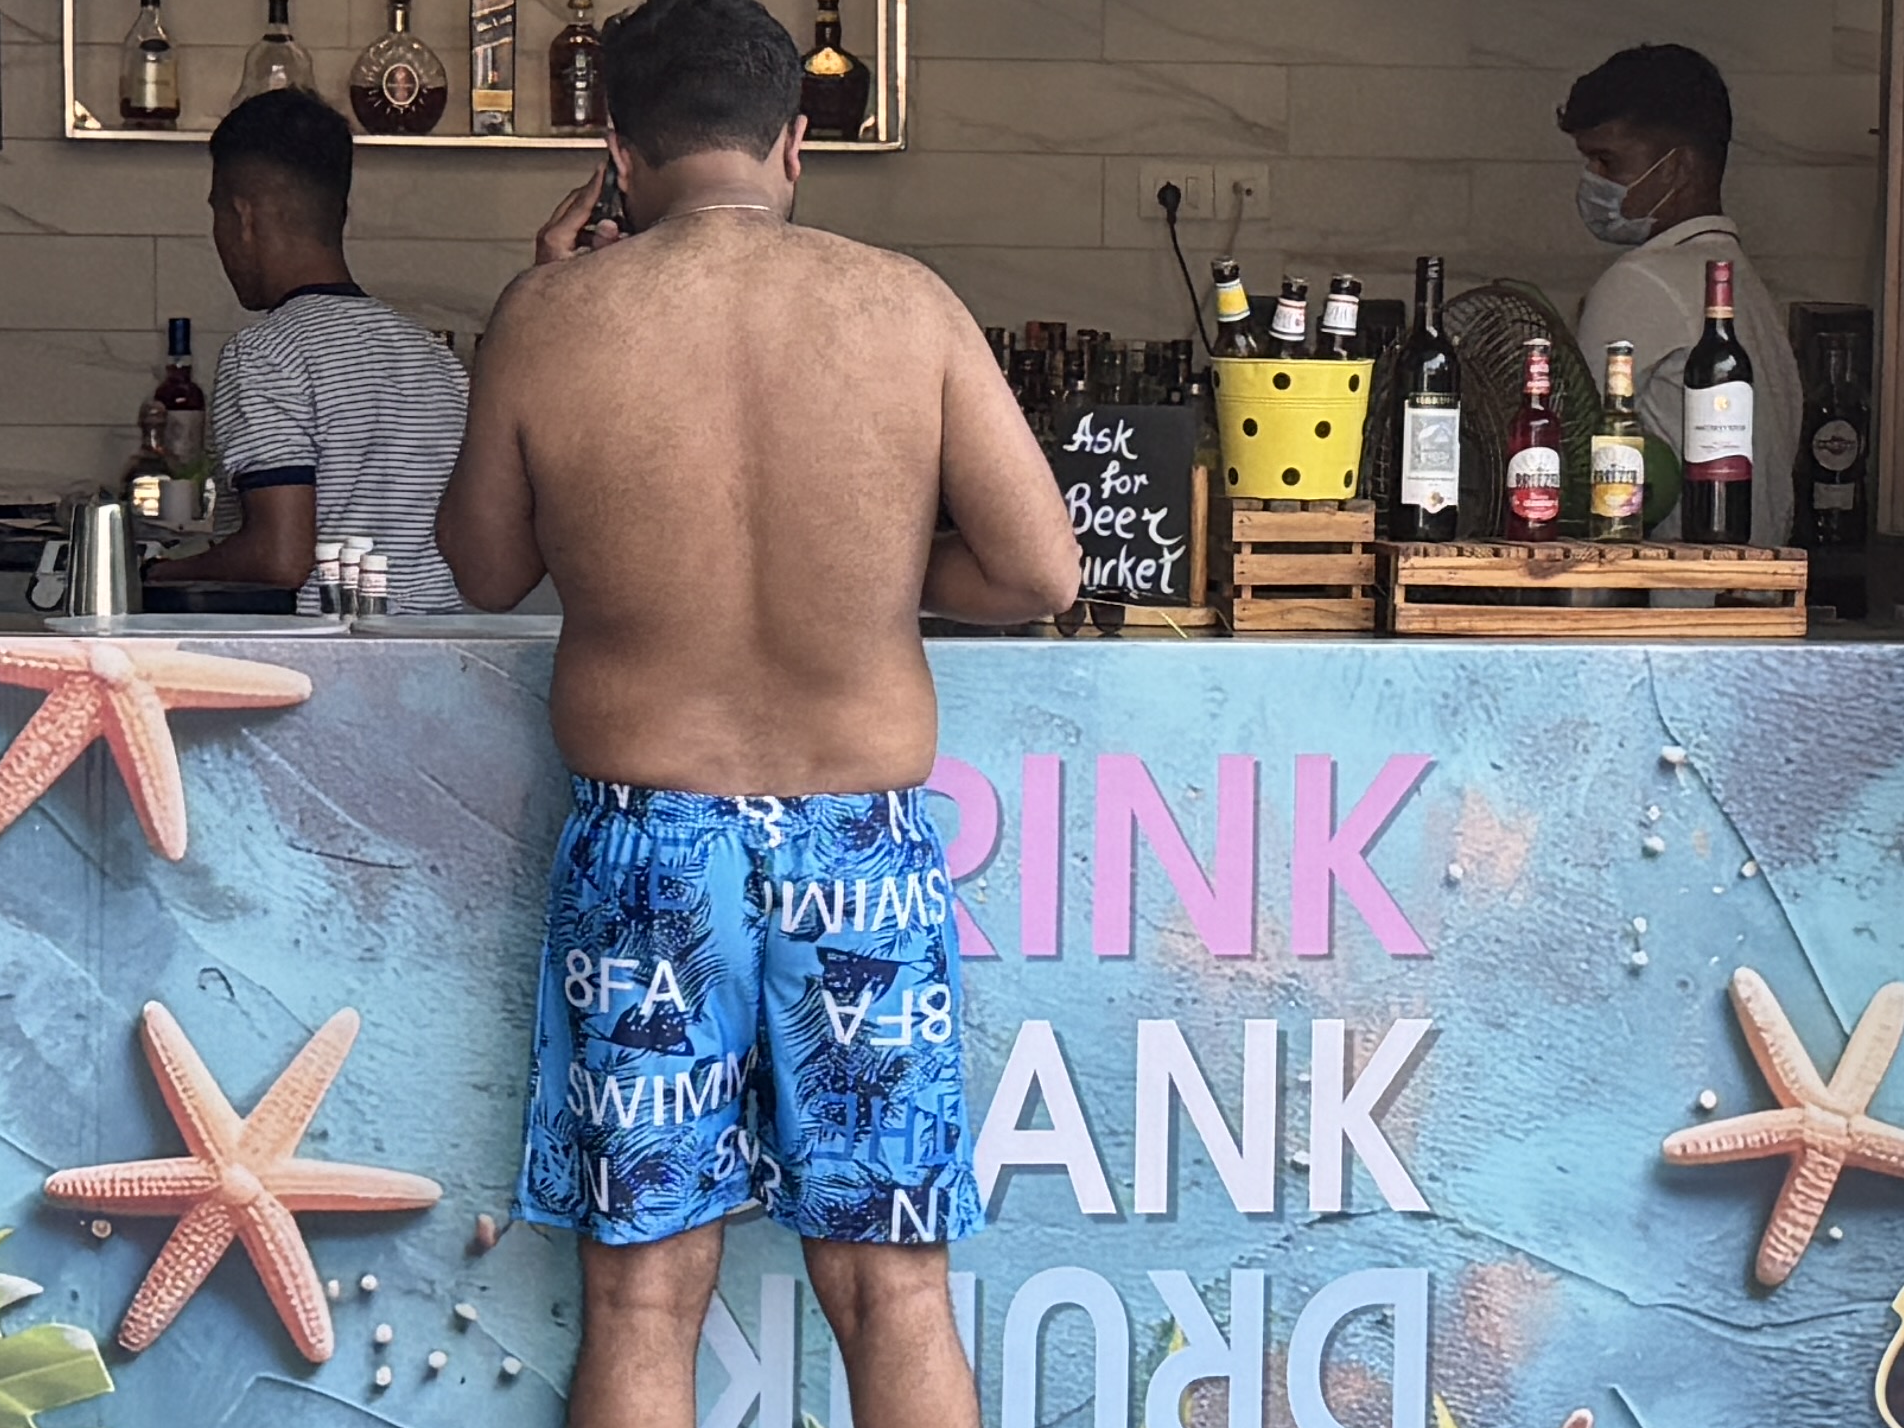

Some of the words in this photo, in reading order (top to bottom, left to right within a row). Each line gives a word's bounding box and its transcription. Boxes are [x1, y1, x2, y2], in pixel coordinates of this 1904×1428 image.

[1062, 412, 1138, 460] Ask
[1100, 460, 1149, 499] for
[1065, 483, 1184, 545] Beer
[564, 949, 687, 1017] 8FA
